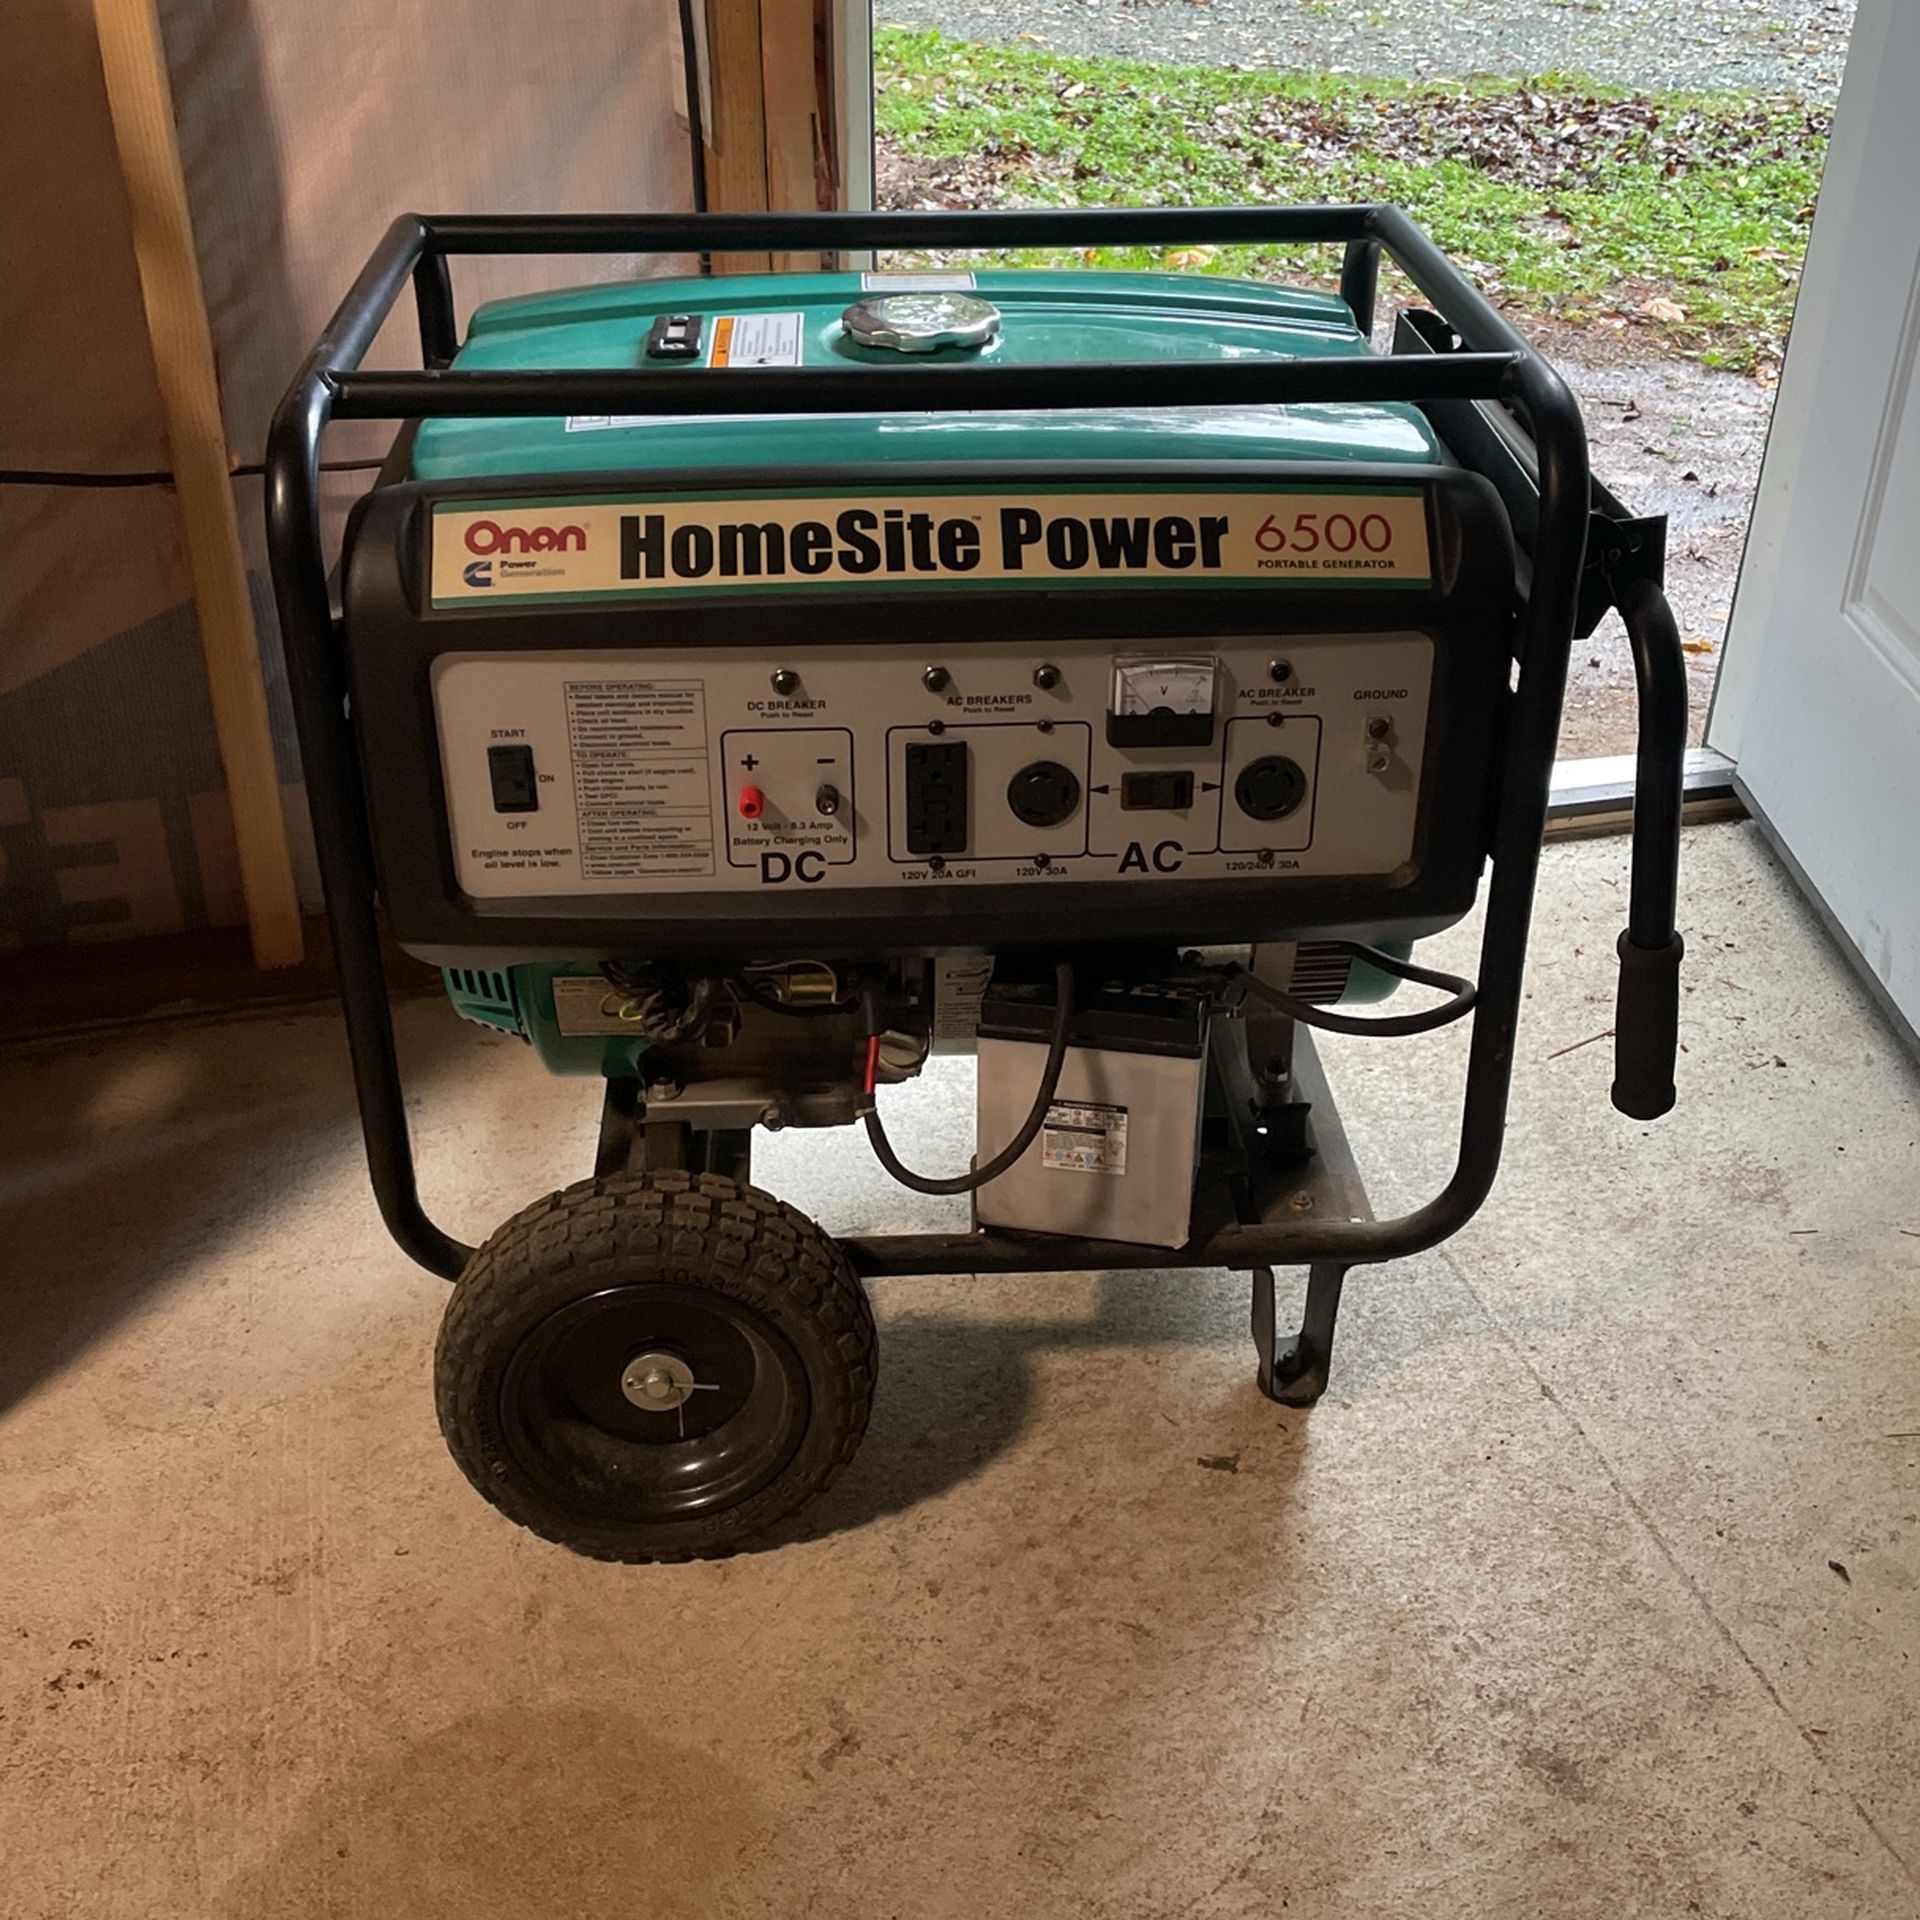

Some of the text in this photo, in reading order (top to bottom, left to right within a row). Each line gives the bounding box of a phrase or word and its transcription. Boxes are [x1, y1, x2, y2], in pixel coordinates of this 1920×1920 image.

[464, 520, 588, 556] Onan
[1255, 513, 1392, 553] 6500
[620, 507, 1228, 580] HomeSite Power
[500, 560, 537, 569] Power
[1257, 558, 1395, 569] PORTABLE GENERATOR
[500, 566, 566, 579] Generation
[1160, 685, 1168, 696] V
[1238, 688, 1316, 698] AC BREAKER
[1353, 688, 1408, 700] GROUND
[747, 700, 826, 711] DC BREAKER
[947, 694, 1032, 706] AC BREAKERS
[490, 729, 526, 739] START
[538, 774, 555, 783] ON
[506, 821, 528, 830] OFF
[747, 823, 759, 832] 12
[762, 823, 781, 832] Volt
[809, 821, 834, 832] Amp
[733, 834, 849, 847] Battery Charging Only
[471, 847, 573, 859] Engine stops when
[1117, 840, 1183, 874] AC
[484, 859, 561, 869] oil level is low.
[761, 851, 826, 884] DC
[1279, 860, 1300, 870] 30A
[901, 869, 976, 880] 120V 20A GFI
[1016, 866, 1068, 877] 120V 30A
